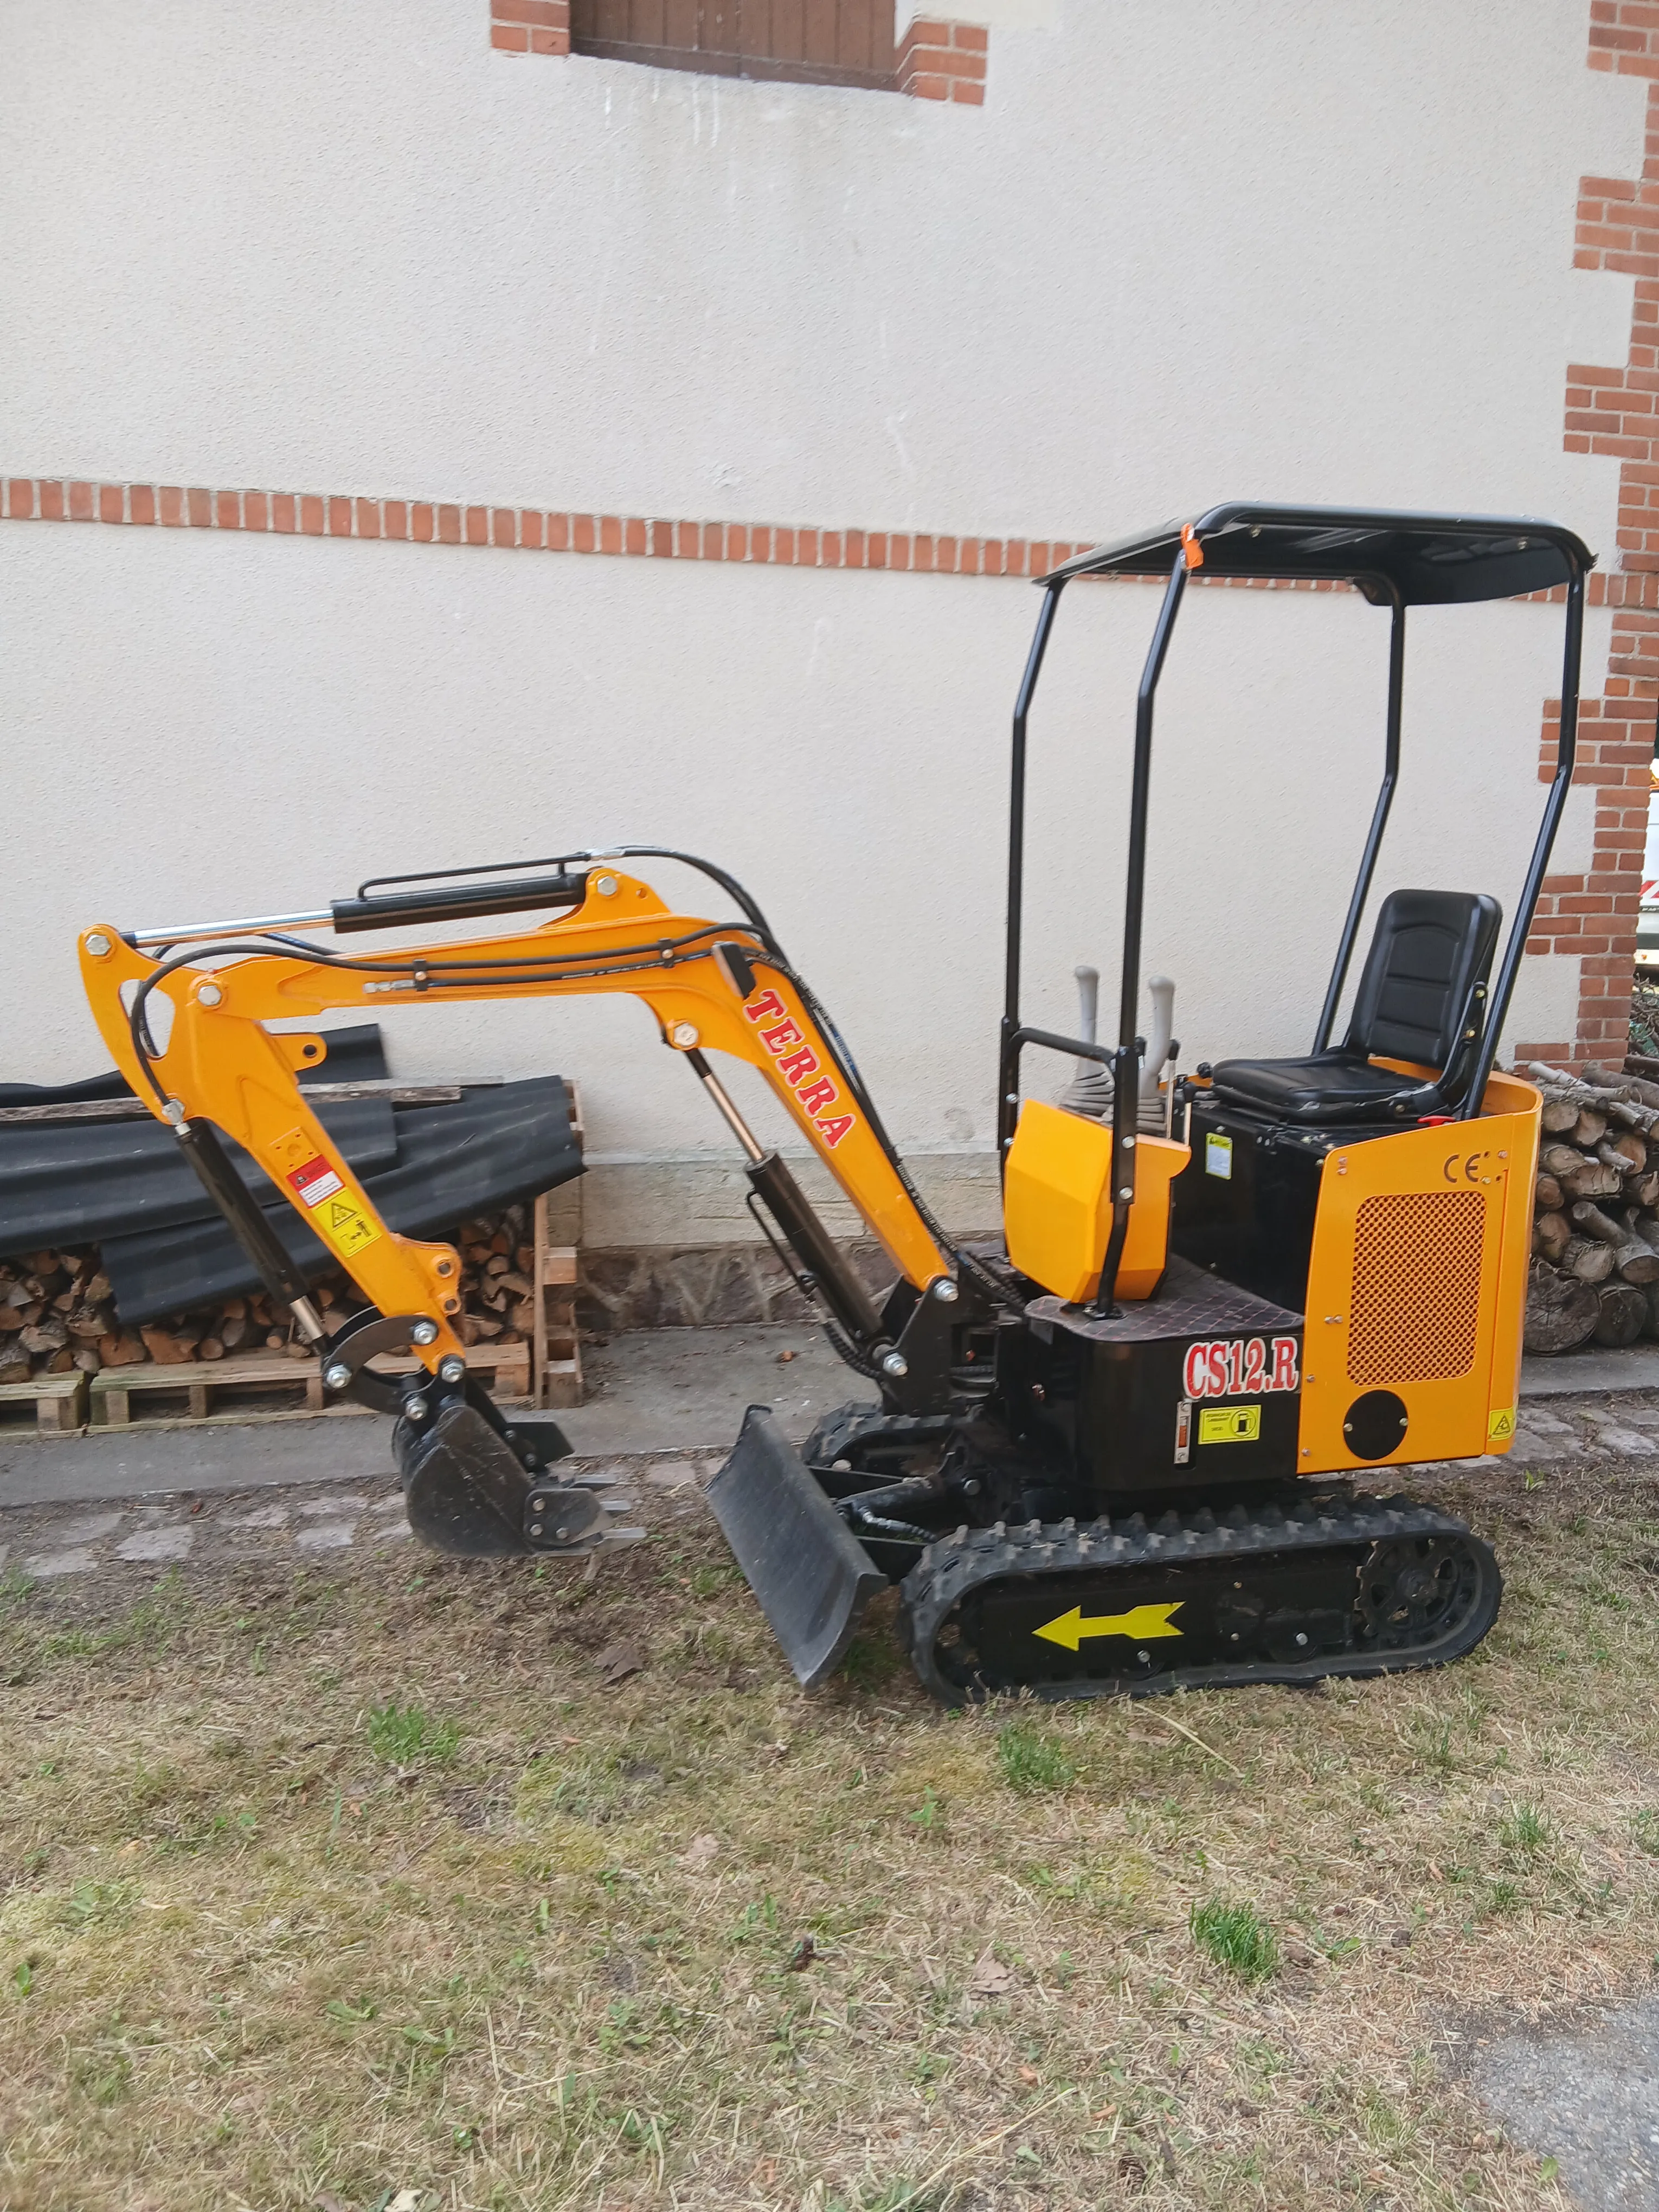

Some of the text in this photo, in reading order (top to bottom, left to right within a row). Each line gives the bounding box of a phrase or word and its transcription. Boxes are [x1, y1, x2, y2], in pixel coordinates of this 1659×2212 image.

[743, 989, 856, 1149] TERRA
[1443, 1153, 1481, 1184] CE
[1183, 1336, 1299, 1399] CS12.R
